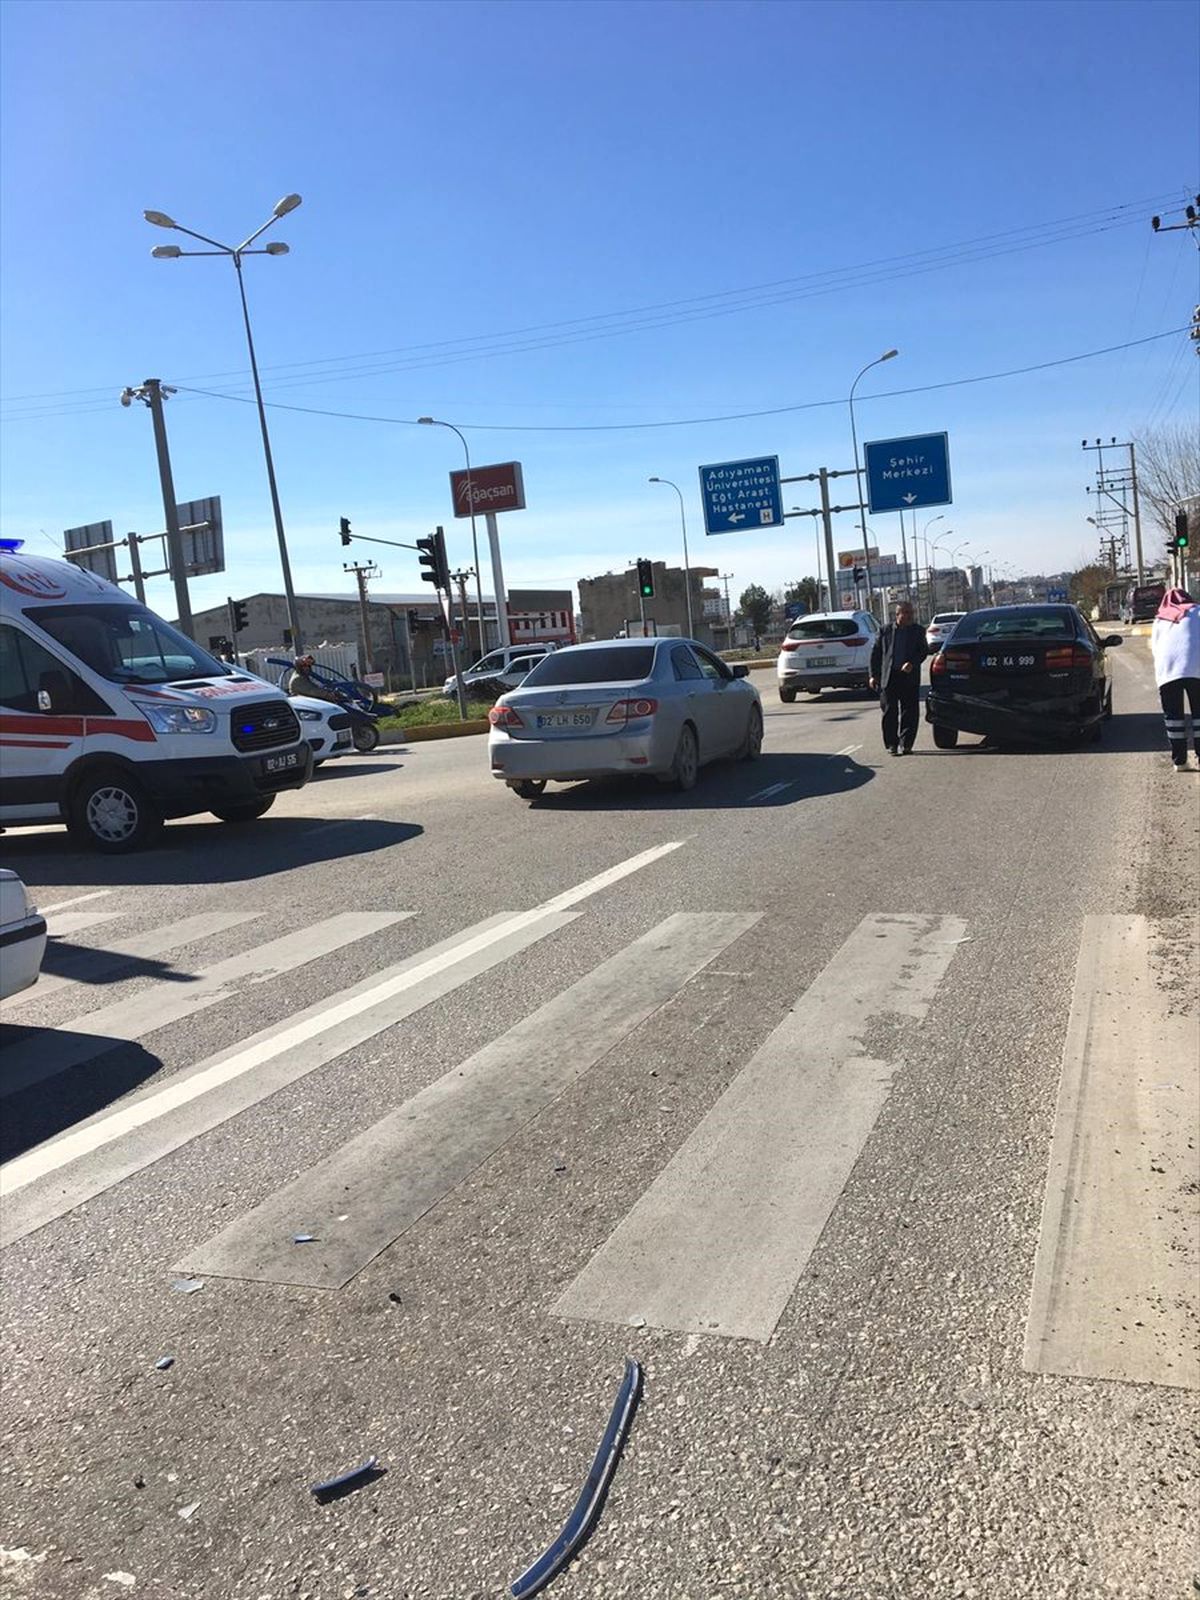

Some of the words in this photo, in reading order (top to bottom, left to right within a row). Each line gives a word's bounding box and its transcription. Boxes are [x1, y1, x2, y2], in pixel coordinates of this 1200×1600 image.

[709, 465, 770, 479] Adıyaman
[883, 465, 934, 480] Merkezi
[712, 498, 774, 513] Hastanesi
[986, 656, 997, 667] 02
[1003, 656, 1014, 667] KA
